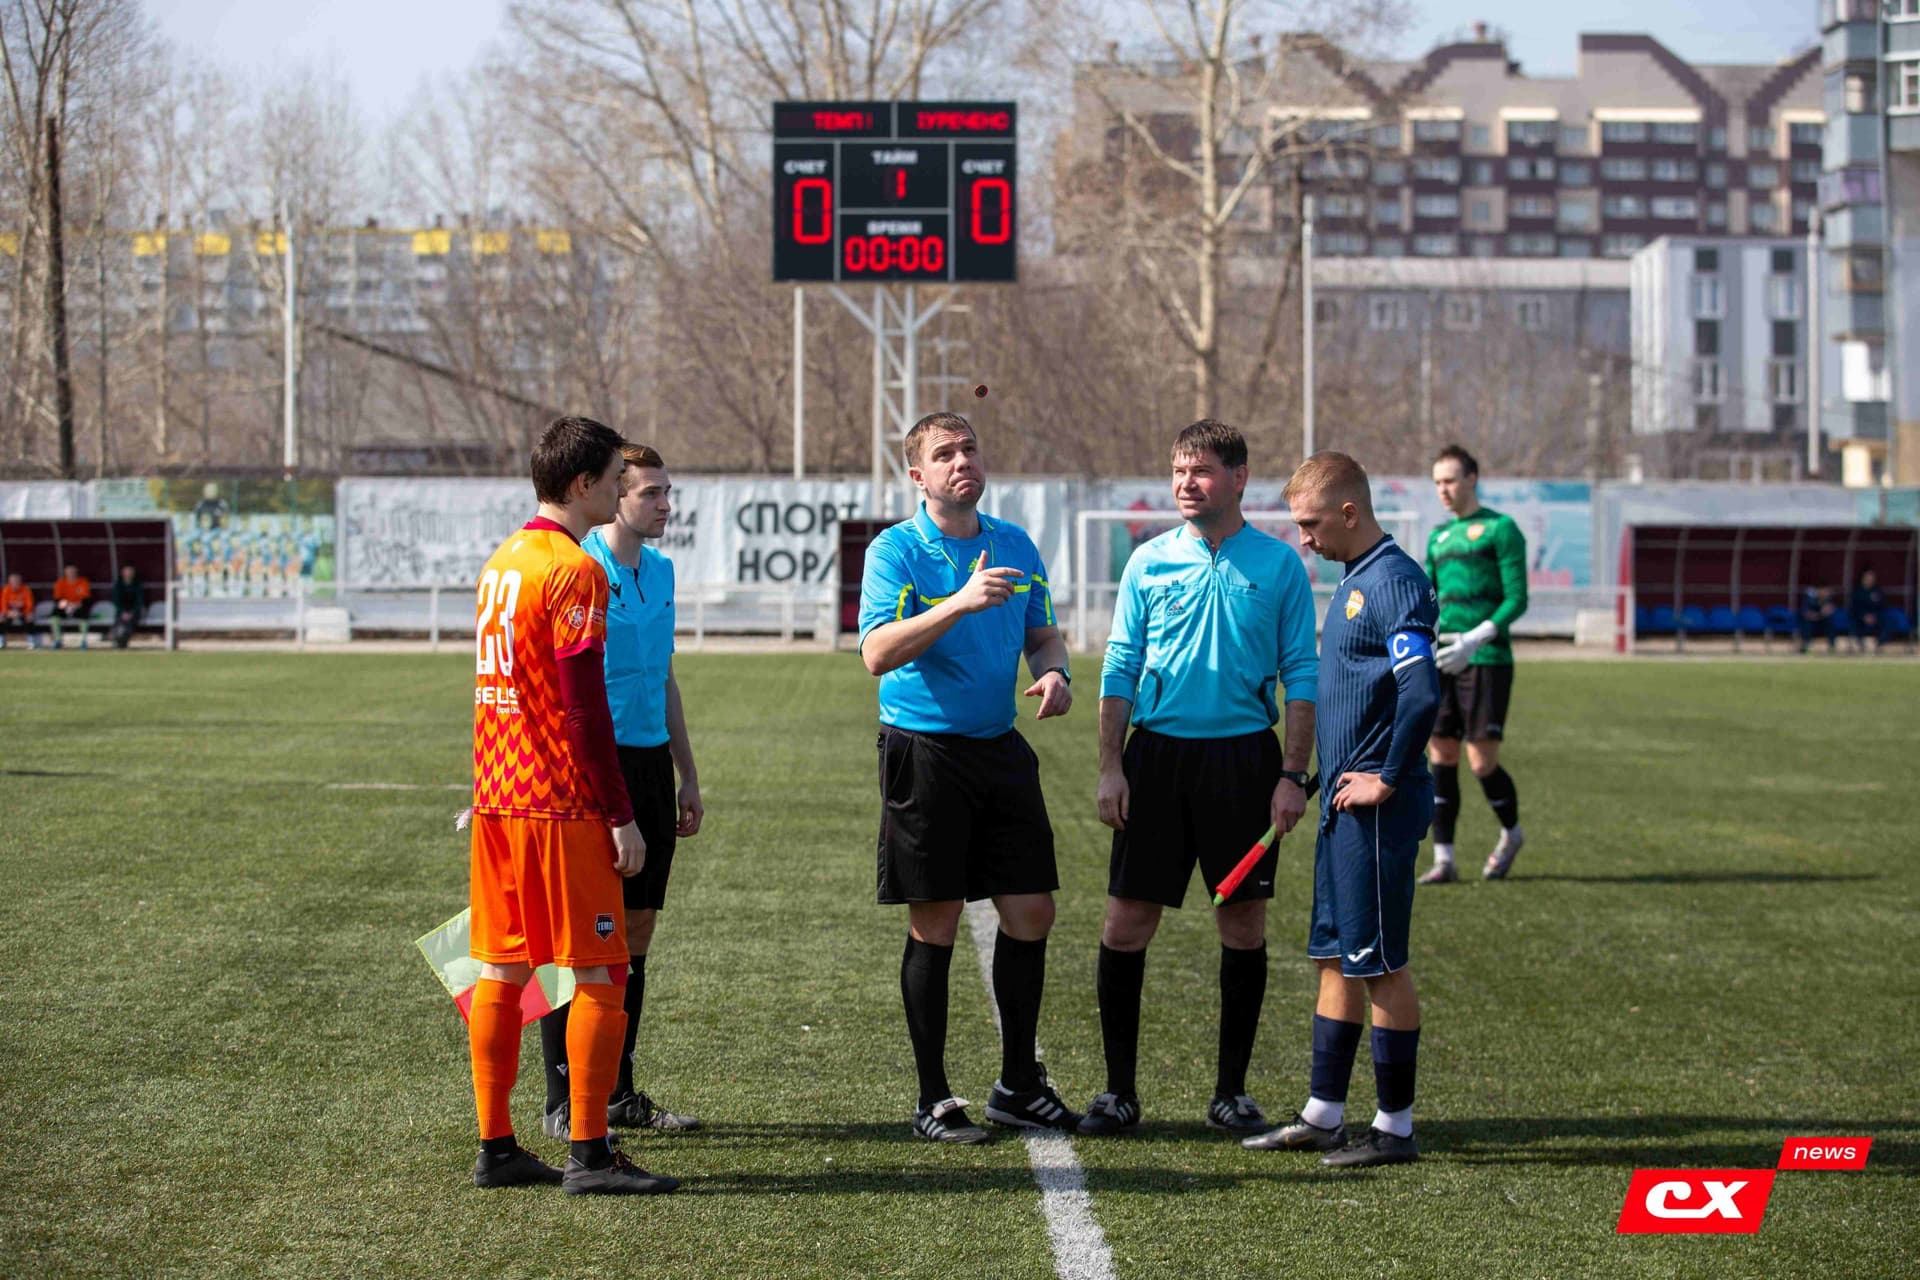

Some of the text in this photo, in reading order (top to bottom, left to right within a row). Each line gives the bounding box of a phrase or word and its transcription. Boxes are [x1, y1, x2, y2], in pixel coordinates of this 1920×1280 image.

[896, 168, 906, 198] 1
[793, 178, 832, 244] 0
[971, 178, 1011, 244] 0
[845, 235, 944, 272] 00:00
[738, 549, 841, 583] НОР
[476, 569, 522, 676] 23
[1392, 633, 1410, 659] C
